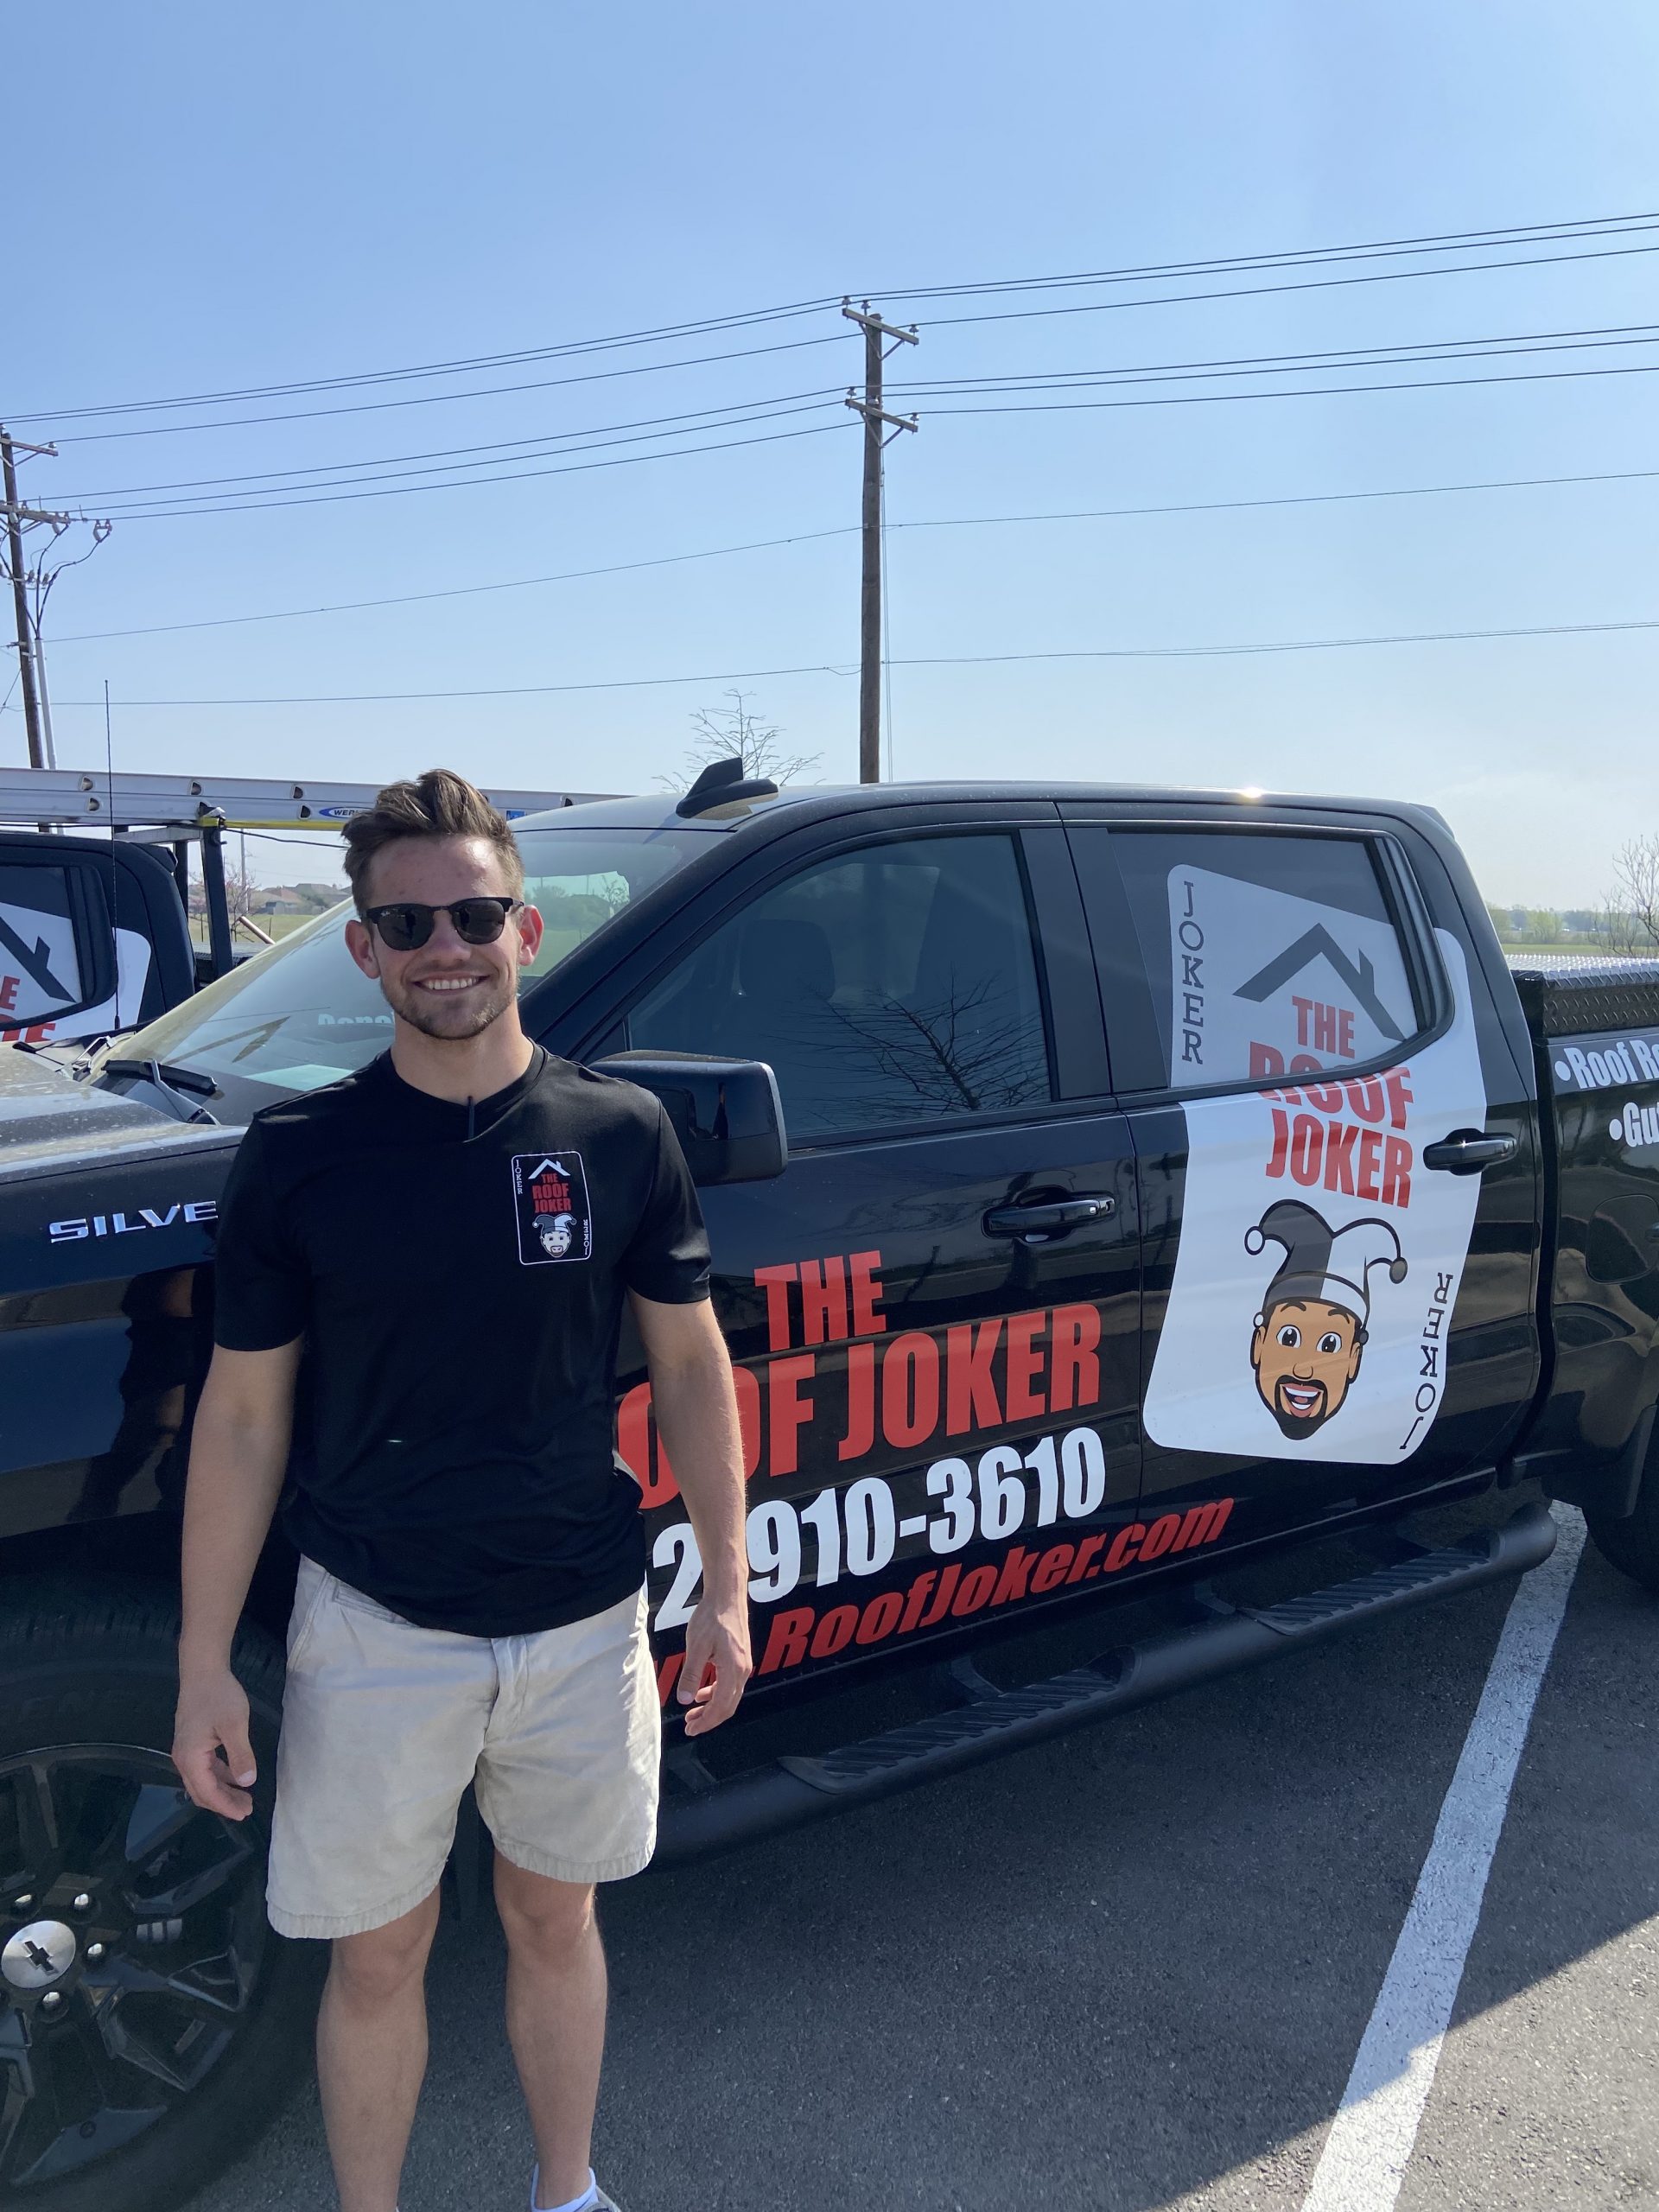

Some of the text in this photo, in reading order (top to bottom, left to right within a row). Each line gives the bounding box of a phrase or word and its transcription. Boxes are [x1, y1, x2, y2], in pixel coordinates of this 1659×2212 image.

[1178, 880, 1205, 1065] JOKER
[1292, 995, 1356, 1058] THE
[1249, 1040, 1414, 1131] ROOF
[1563, 1041, 1639, 1090] Roof
[1265, 1109, 1414, 1210] JOKER
[1622, 1101, 1659, 1147] Gu
[514, 1159, 523, 1194] JOKER
[531, 1183, 569, 1199] ROOF
[534, 1198, 572, 1213] JOKER
[541, 1173, 558, 1183] THE
[754, 1249, 887, 1352] THE
[837, 1303, 1102, 1462] JOKER
[1398, 1271, 1455, 1451] JOKER
[652, 1427, 1106, 1632] 2910-3610
